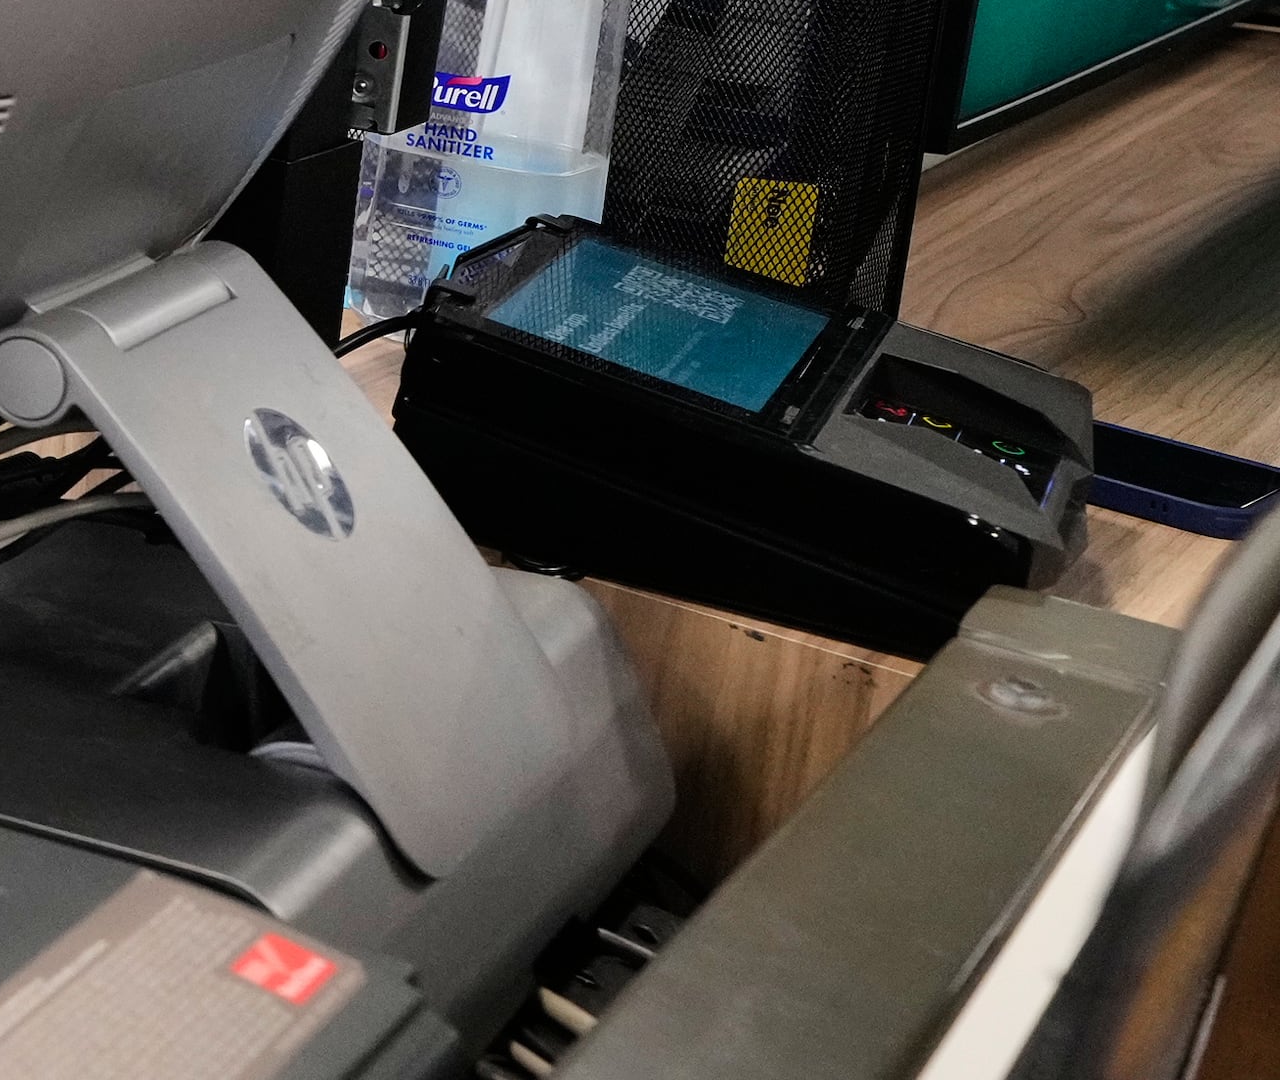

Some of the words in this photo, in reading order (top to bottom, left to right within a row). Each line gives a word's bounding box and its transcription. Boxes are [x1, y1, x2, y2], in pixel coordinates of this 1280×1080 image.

[424, 123, 477, 142] HAND
[406, 134, 494, 160] SANITIZER
[407, 233, 454, 249] REFRESHING
